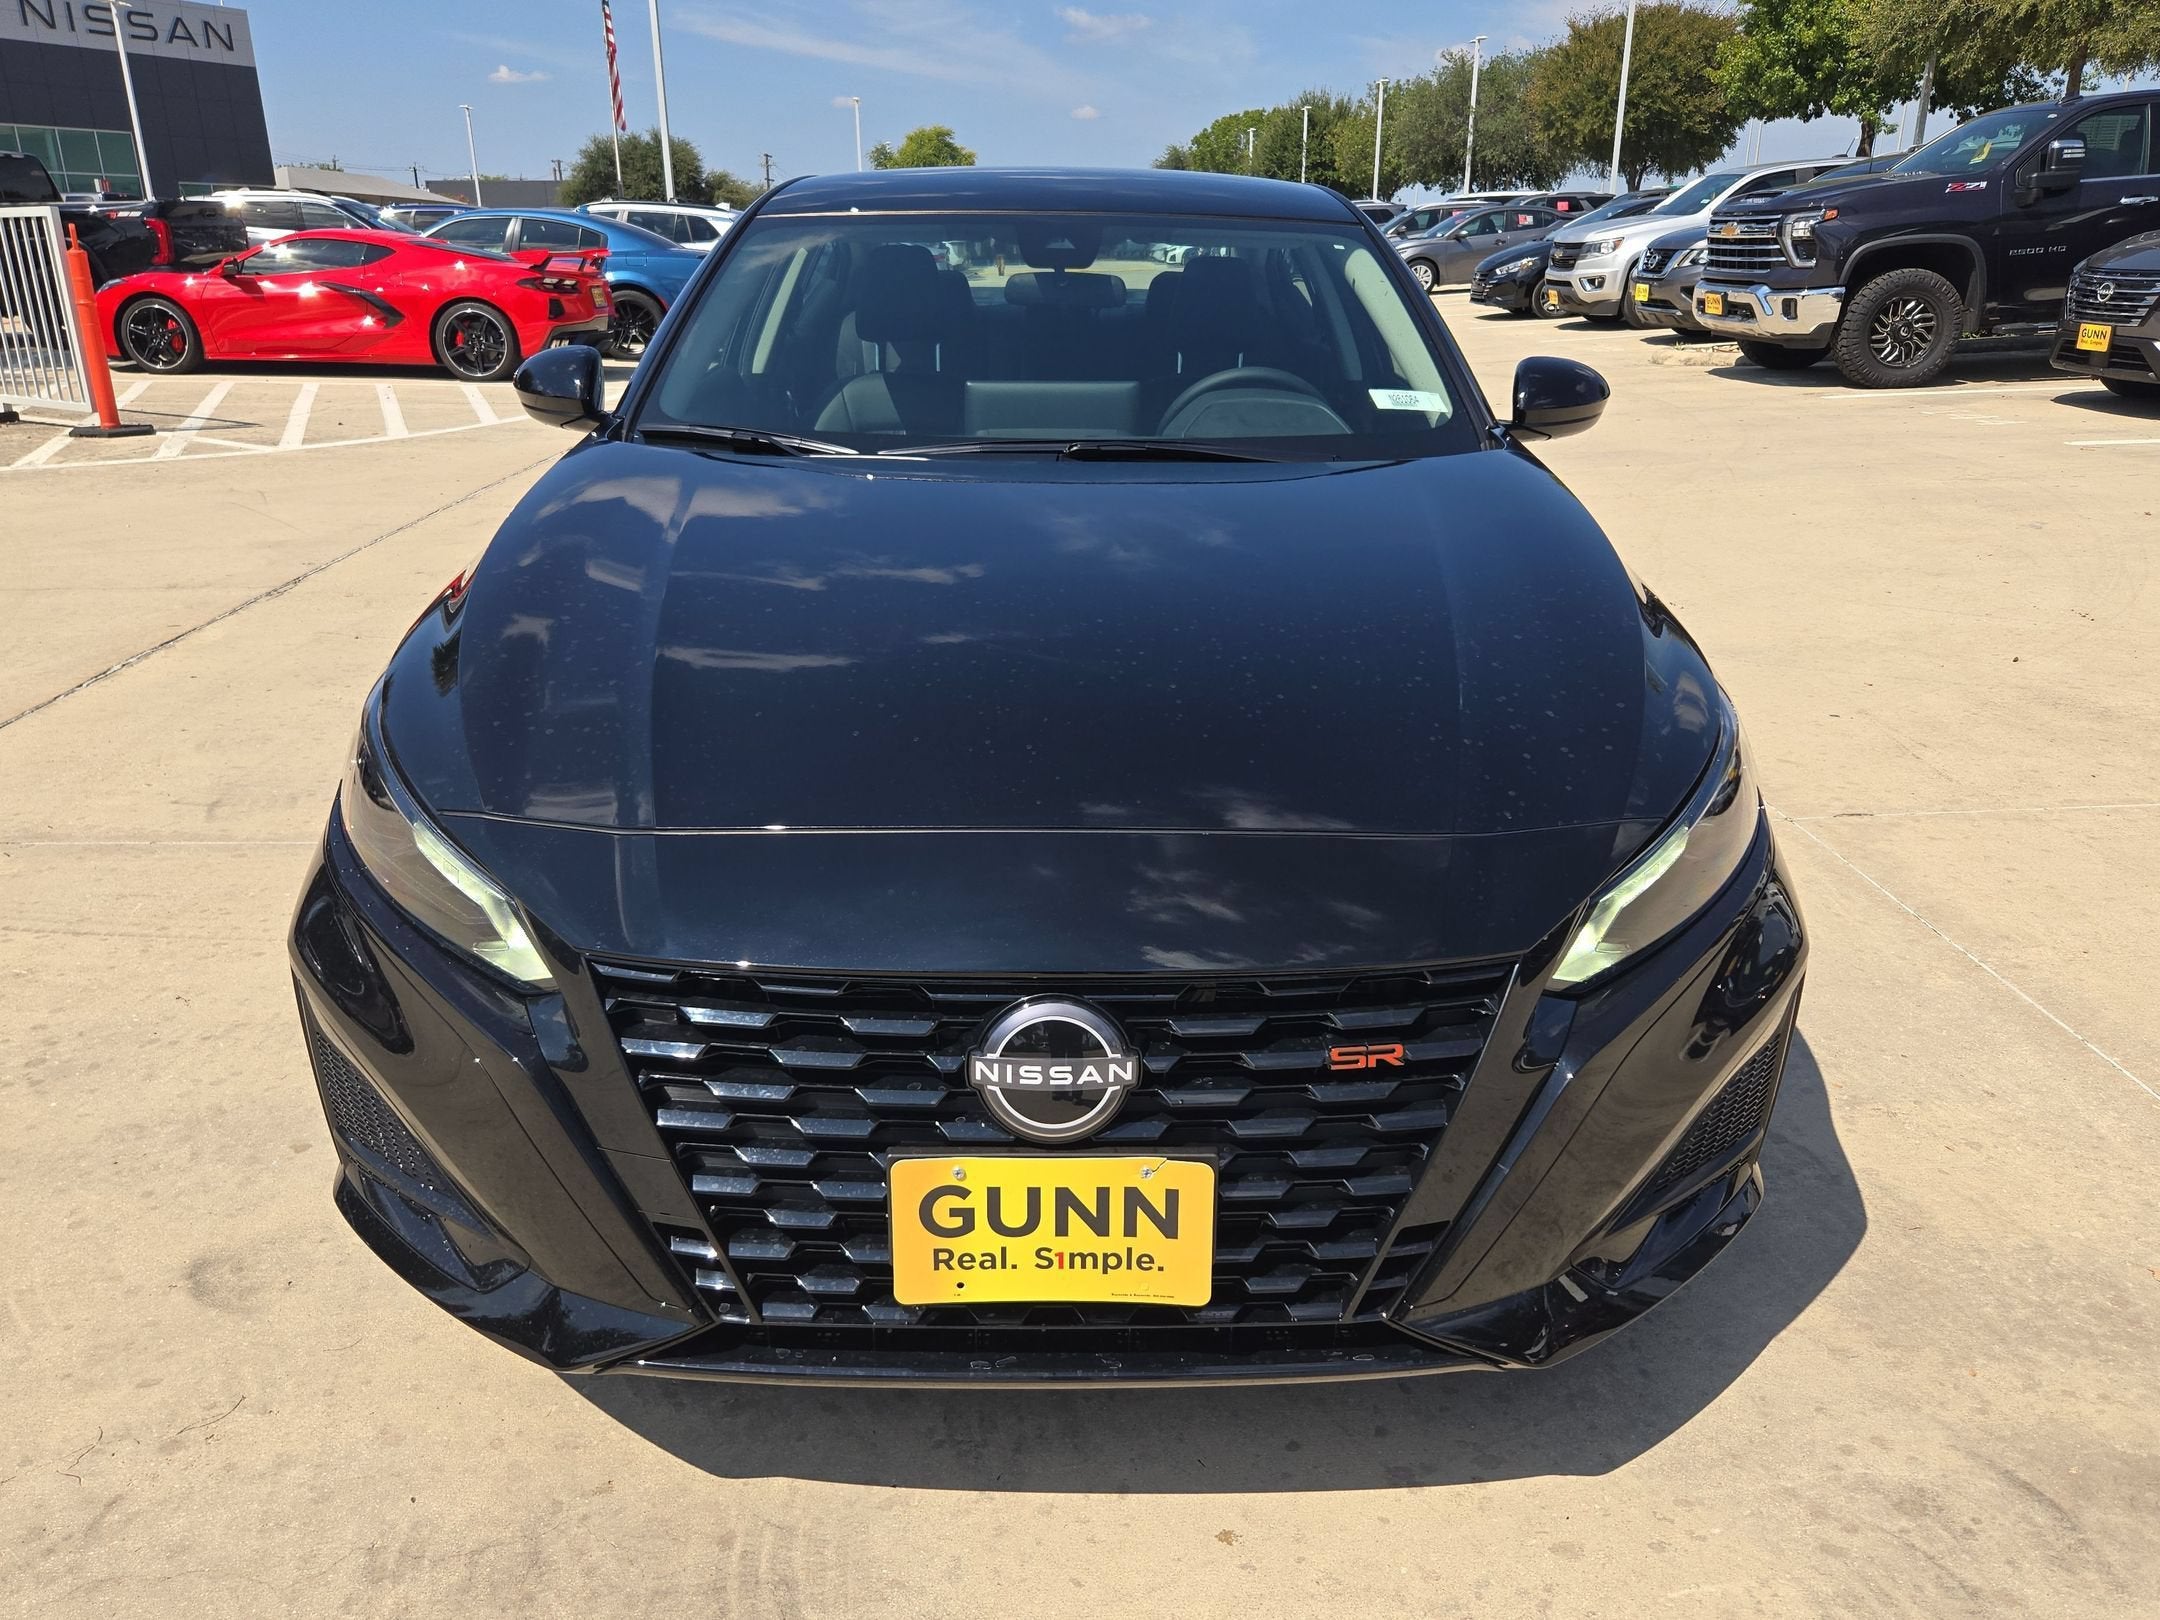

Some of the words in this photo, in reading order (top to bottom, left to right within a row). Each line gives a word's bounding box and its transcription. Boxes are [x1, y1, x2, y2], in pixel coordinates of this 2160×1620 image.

[18, 0, 235, 51] NISSAN
[2081, 328, 2108, 340] GUNN
[1330, 1043, 1405, 1070] SR
[975, 1061, 1133, 1085] NISSAN
[919, 1184, 1180, 1239] GUNN
[933, 1247, 1018, 1271] Real.
